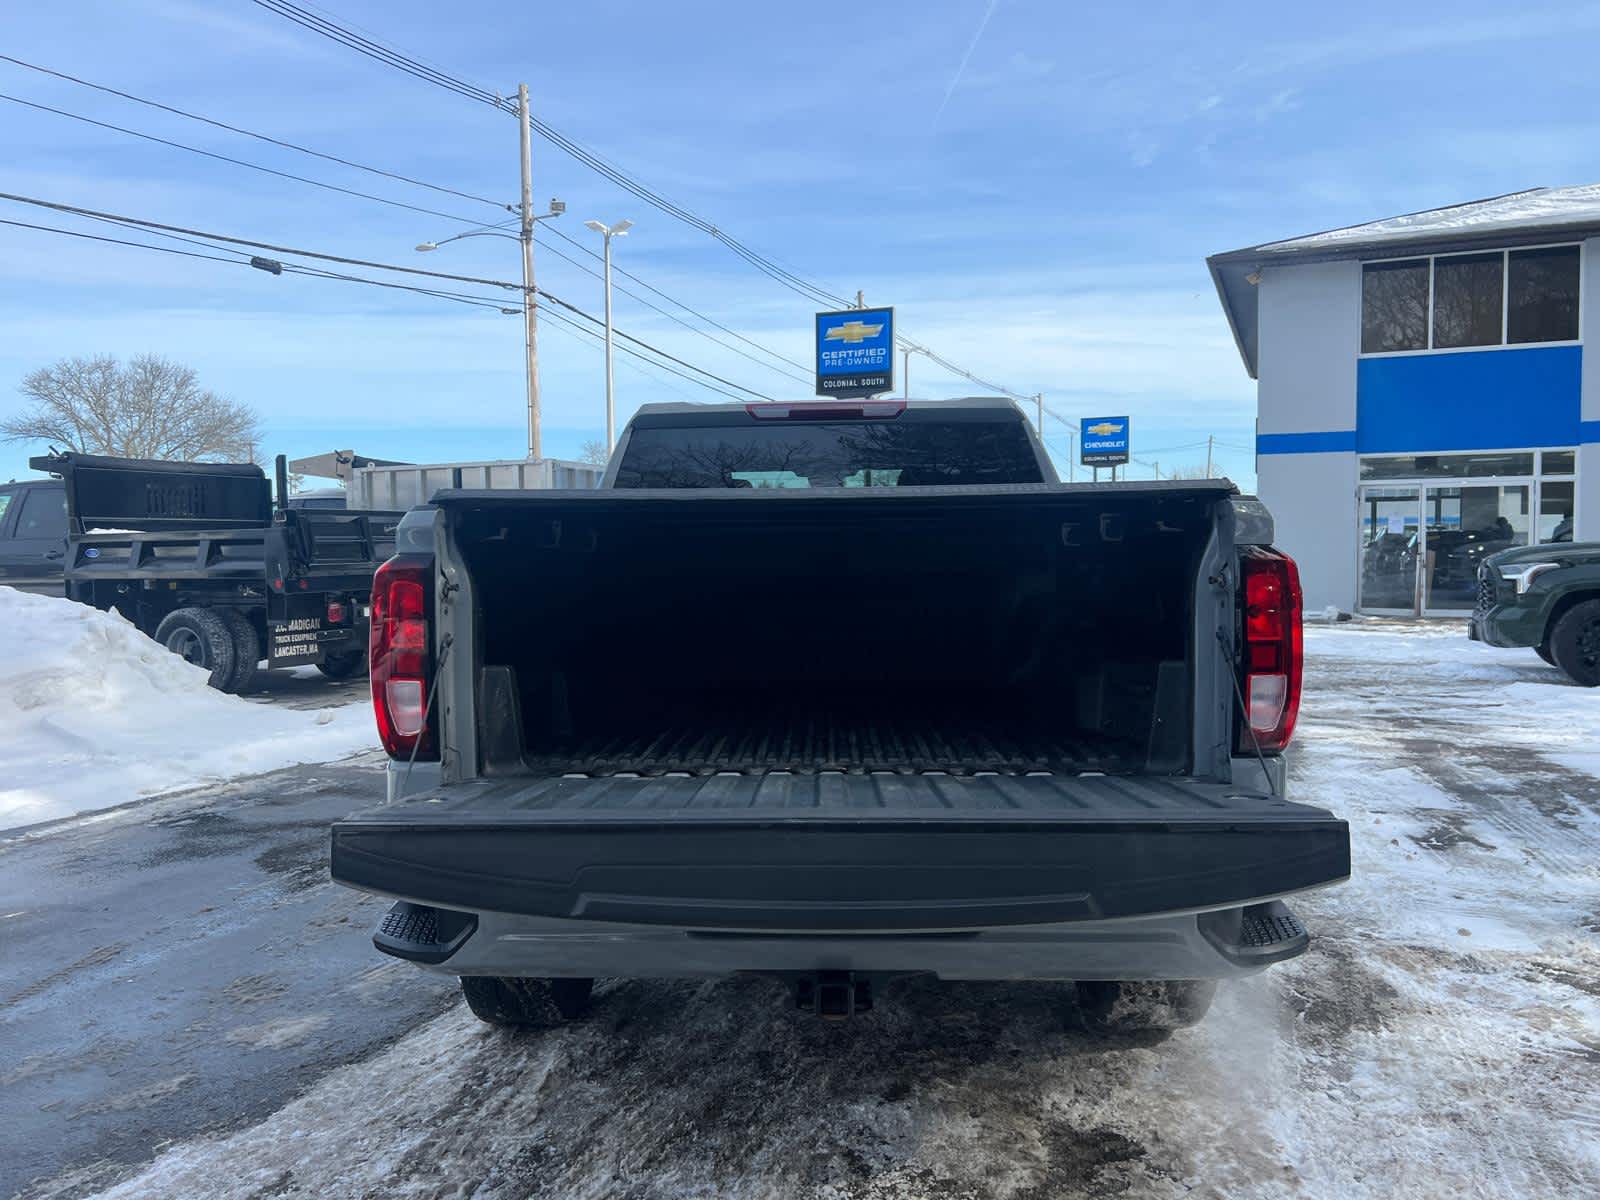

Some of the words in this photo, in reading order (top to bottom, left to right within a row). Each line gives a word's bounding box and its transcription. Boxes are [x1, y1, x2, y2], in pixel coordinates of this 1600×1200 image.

[822, 348, 886, 360] CERTIFIED
[823, 379, 858, 388] COLONIAL
[861, 377, 885, 386] SOUTH
